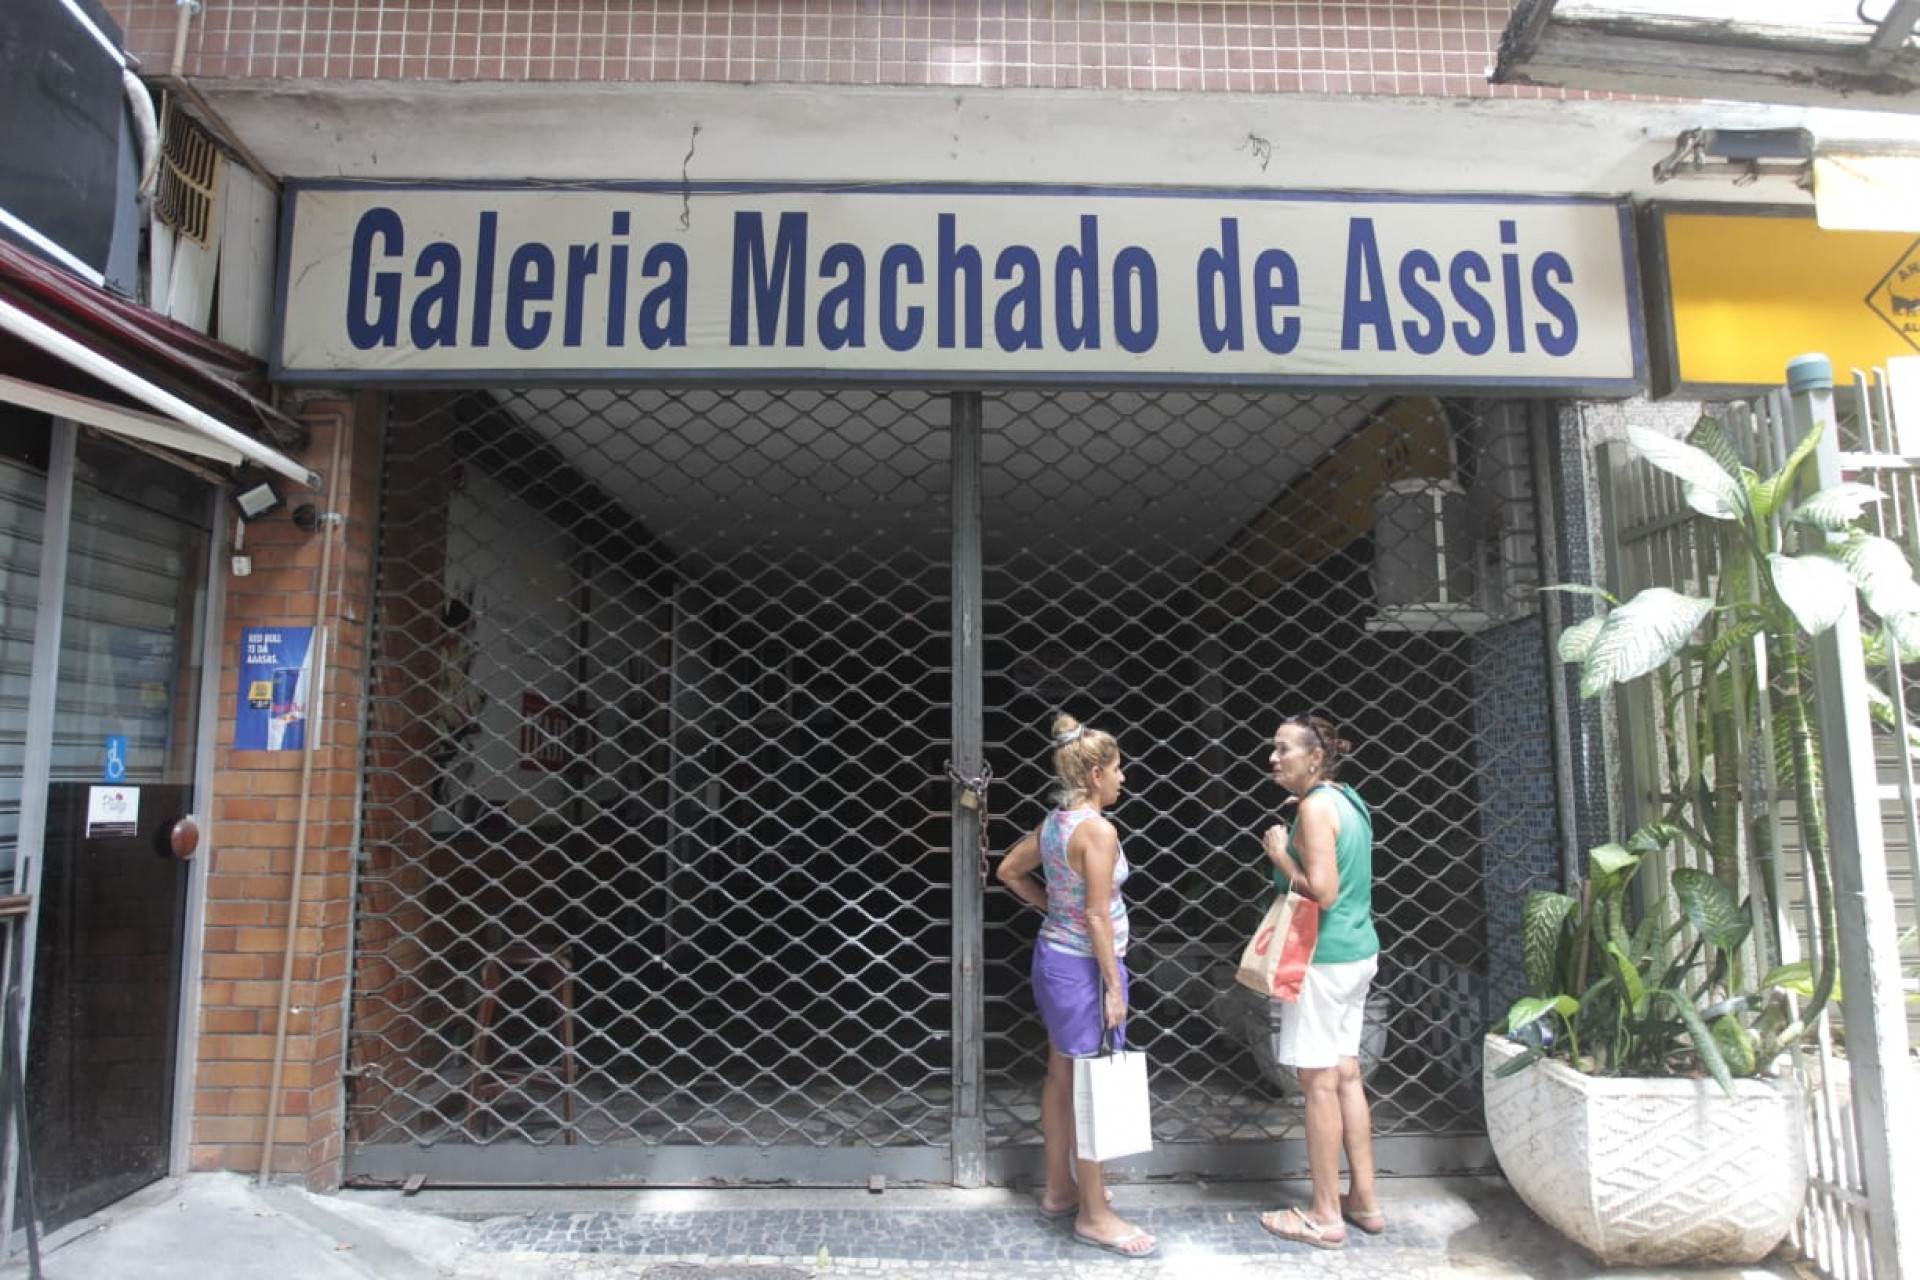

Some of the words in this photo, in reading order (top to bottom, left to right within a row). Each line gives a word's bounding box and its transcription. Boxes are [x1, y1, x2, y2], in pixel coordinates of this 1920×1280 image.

[348, 209, 687, 349] Galeria
[731, 212, 1159, 352] Machado
[1198, 217, 1302, 354] de
[1342, 217, 1580, 357] Assis
